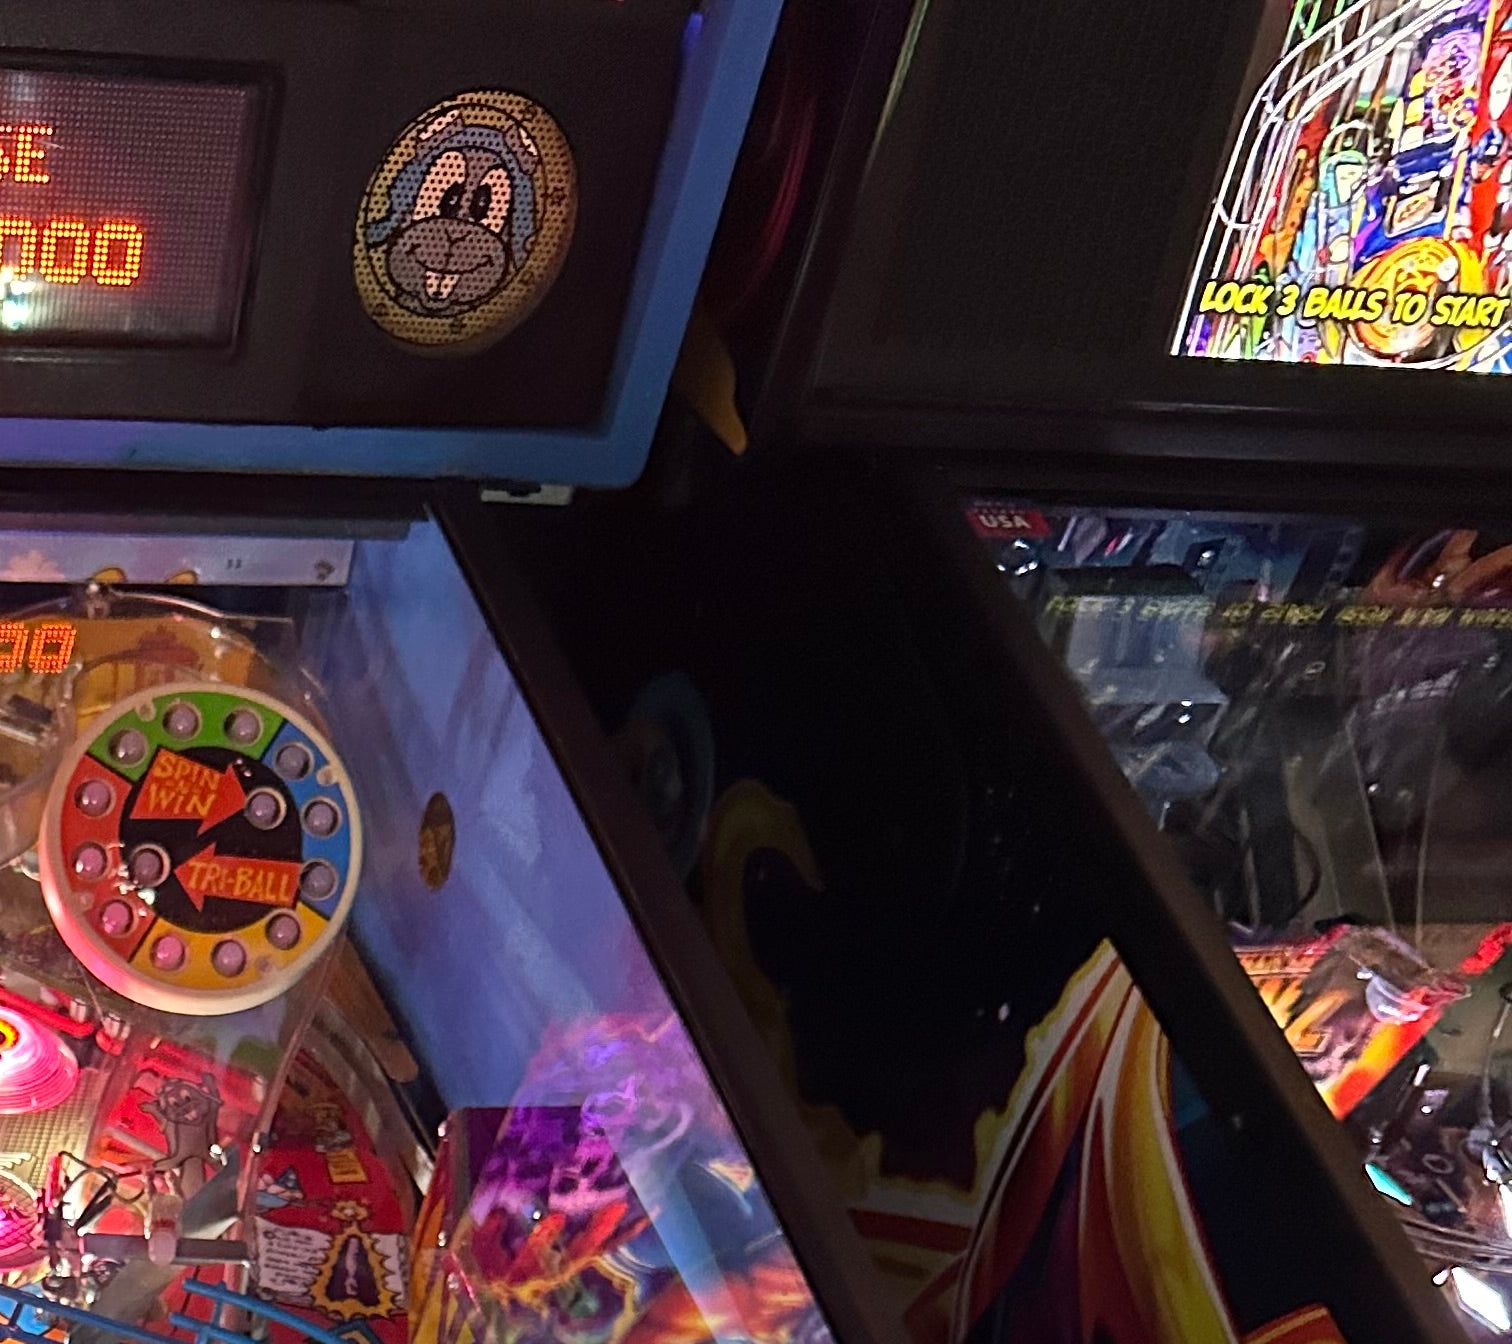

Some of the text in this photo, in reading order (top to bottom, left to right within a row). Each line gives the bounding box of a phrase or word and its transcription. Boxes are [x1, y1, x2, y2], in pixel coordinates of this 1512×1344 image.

[1200, 281, 1509, 328] LOCK 3 BALLS TO START
[978, 515, 1032, 530] USA
[152, 756, 223, 791] SPIN
[147, 783, 217, 818] WIN
[188, 862, 292, 901] TRI-BALL
